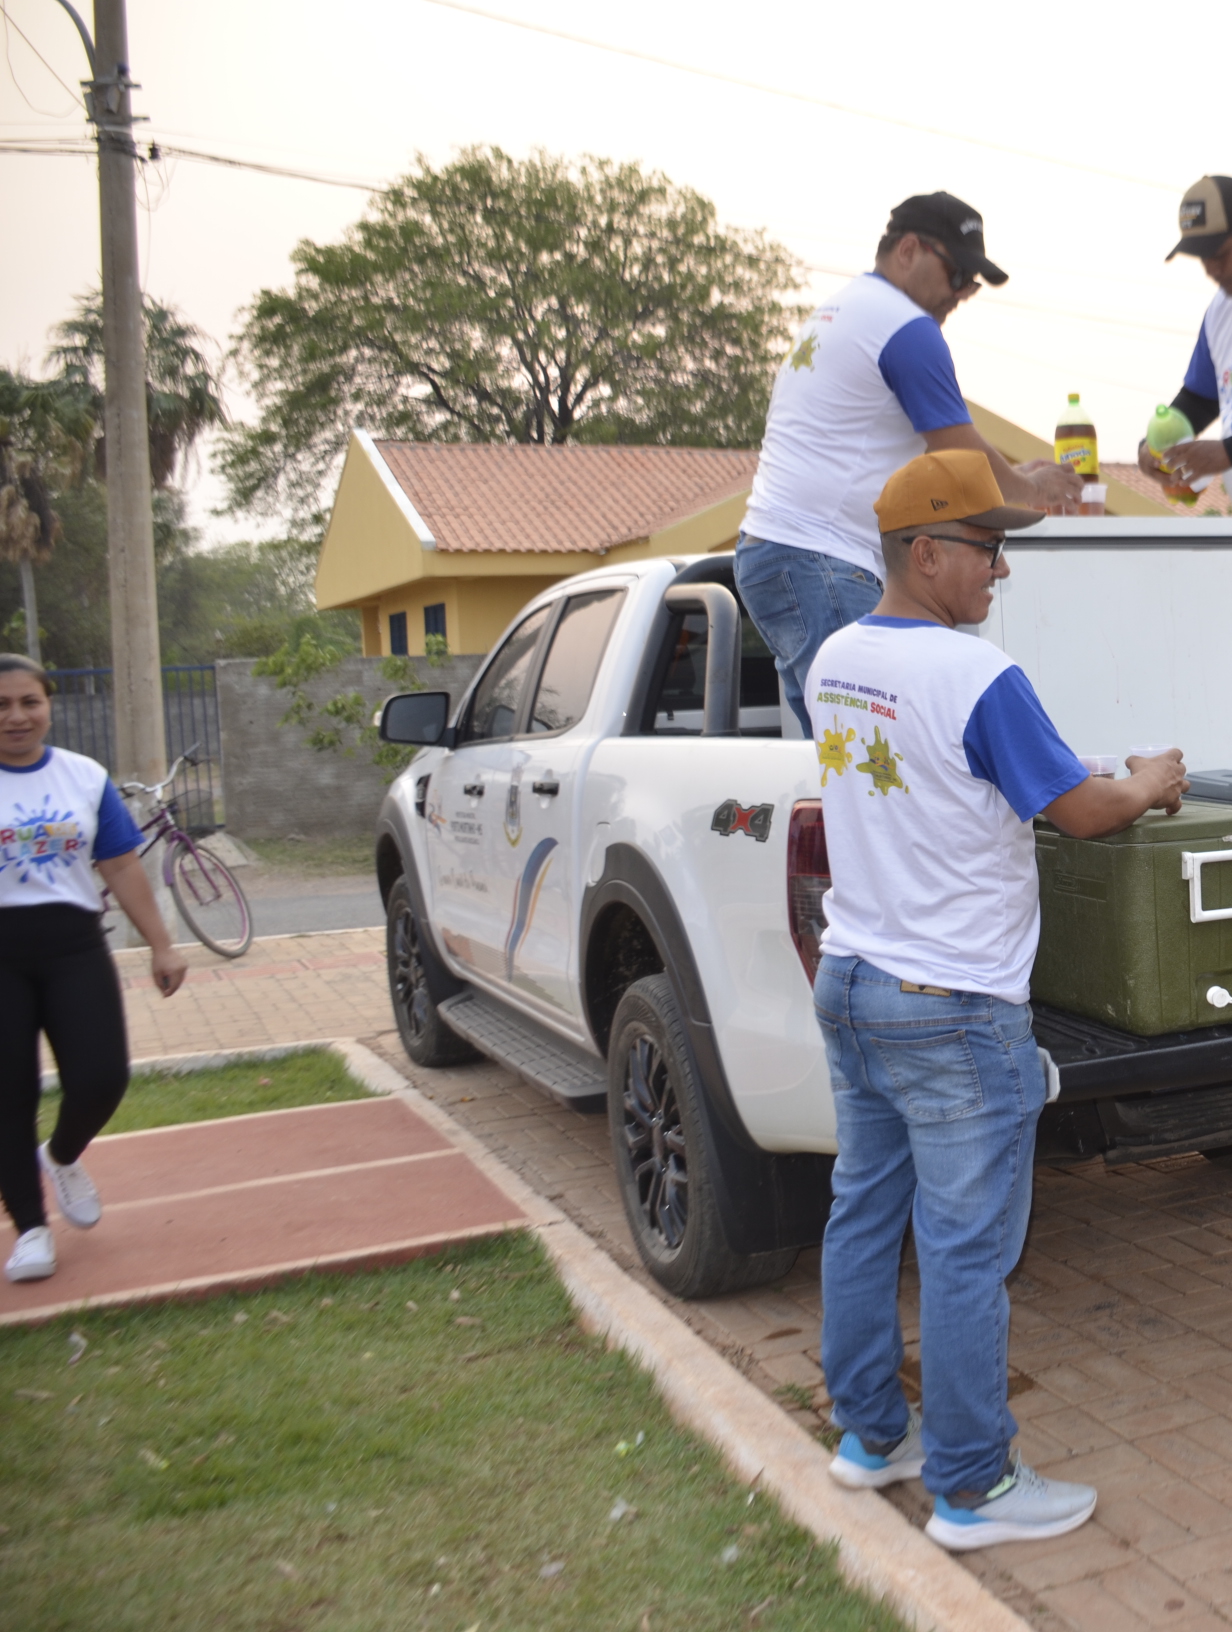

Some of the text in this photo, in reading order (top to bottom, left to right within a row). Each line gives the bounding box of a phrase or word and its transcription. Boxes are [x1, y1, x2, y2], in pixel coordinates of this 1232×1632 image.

[820, 678, 898, 704] SECRETARIA MUNICIPAL DE
[816, 692, 897, 720] ASSISTÊNCIA SOCIAL
[1, 838, 80, 861] LAZER
